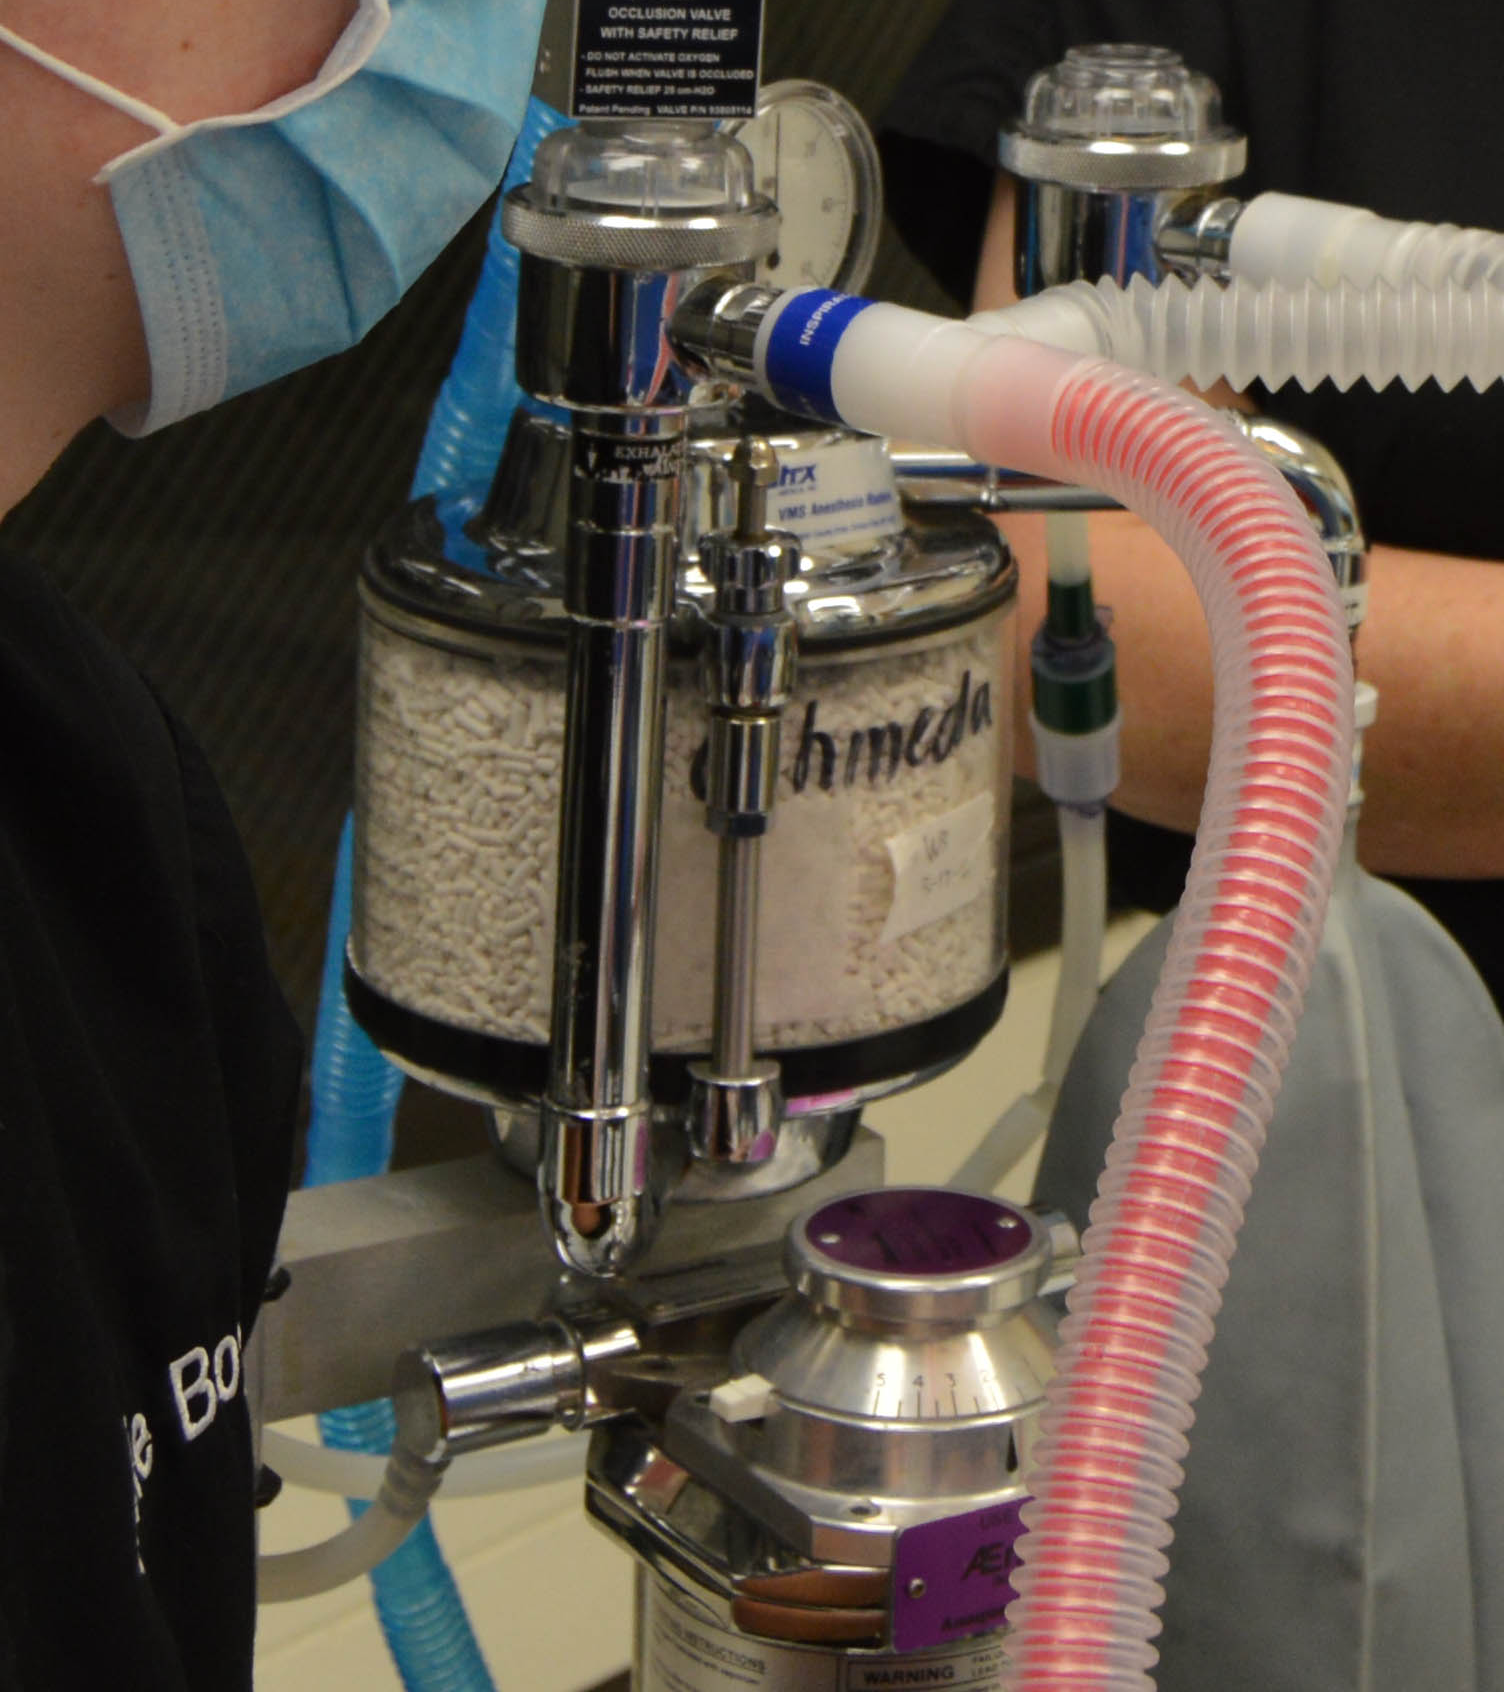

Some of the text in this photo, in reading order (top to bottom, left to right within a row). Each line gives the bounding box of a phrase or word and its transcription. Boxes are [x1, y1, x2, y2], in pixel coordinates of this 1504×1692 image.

[608, 7, 731, 21] OCCLUSION VALVE
[601, 26, 738, 41] WITH SAFETY RELIEF
[605, 52, 625, 61] NOT
[629, 52, 675, 62] ACTIVATE
[677, 53, 720, 63] OXYGEN
[586, 68, 618, 78] FLUSH
[621, 68, 651, 79] WHEN
[653, 69, 685, 79] VALVE
[699, 69, 754, 80] OCCLUDED
[585, 84, 623, 95] SAFETY
[626, 85, 661, 95] RELIEF
[656, 105, 689, 115] VALVE
[876, 1372, 887, 1387] 5
[912, 1375, 924, 1388] 4
[946, 1373, 957, 1388] 3
[863, 1665, 955, 1686] WARNING
